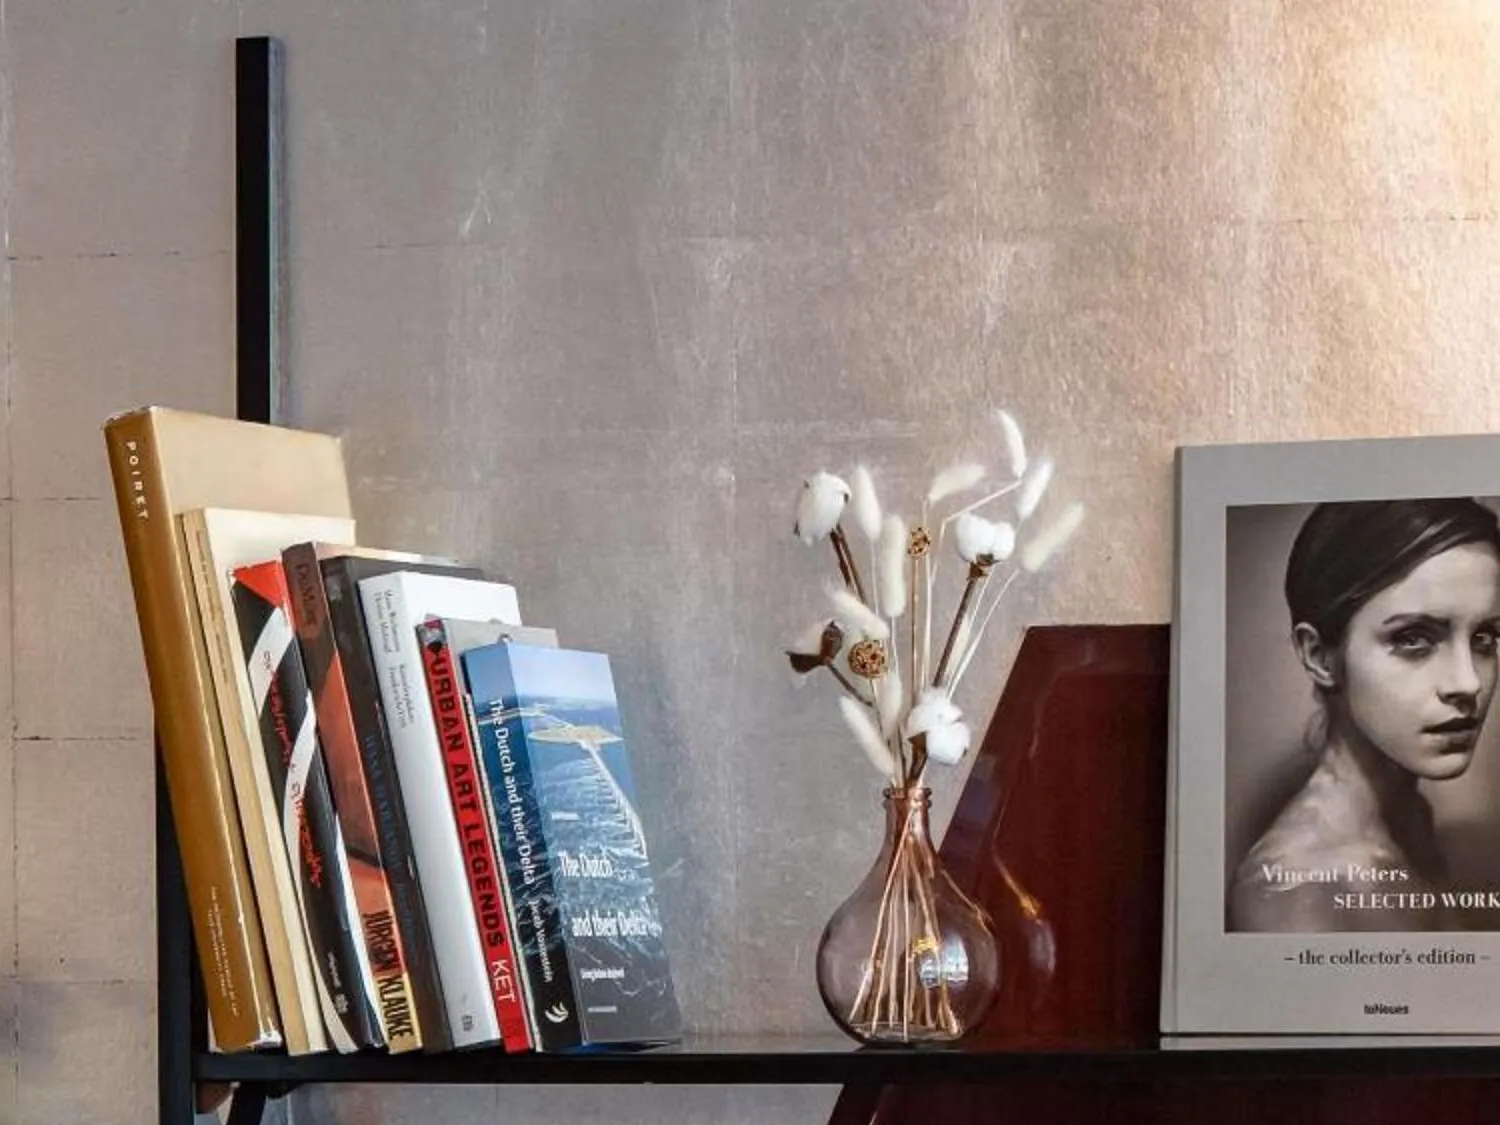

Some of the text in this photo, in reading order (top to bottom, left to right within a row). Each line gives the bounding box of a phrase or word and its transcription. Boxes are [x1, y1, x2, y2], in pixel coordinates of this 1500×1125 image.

[125, 440, 149, 519] POIRET
[489, 698, 536, 885] The Dutch and their Delta
[429, 657, 516, 1003] URBAN ART LEGENDS KET
[558, 850, 614, 877] The Dutch
[1261, 863, 1409, 884] Vincent Peters
[1333, 892, 1436, 910] SELECTED
[1299, 947, 1476, 966] the collector's edition
[377, 975, 414, 1041] KLAUKE
